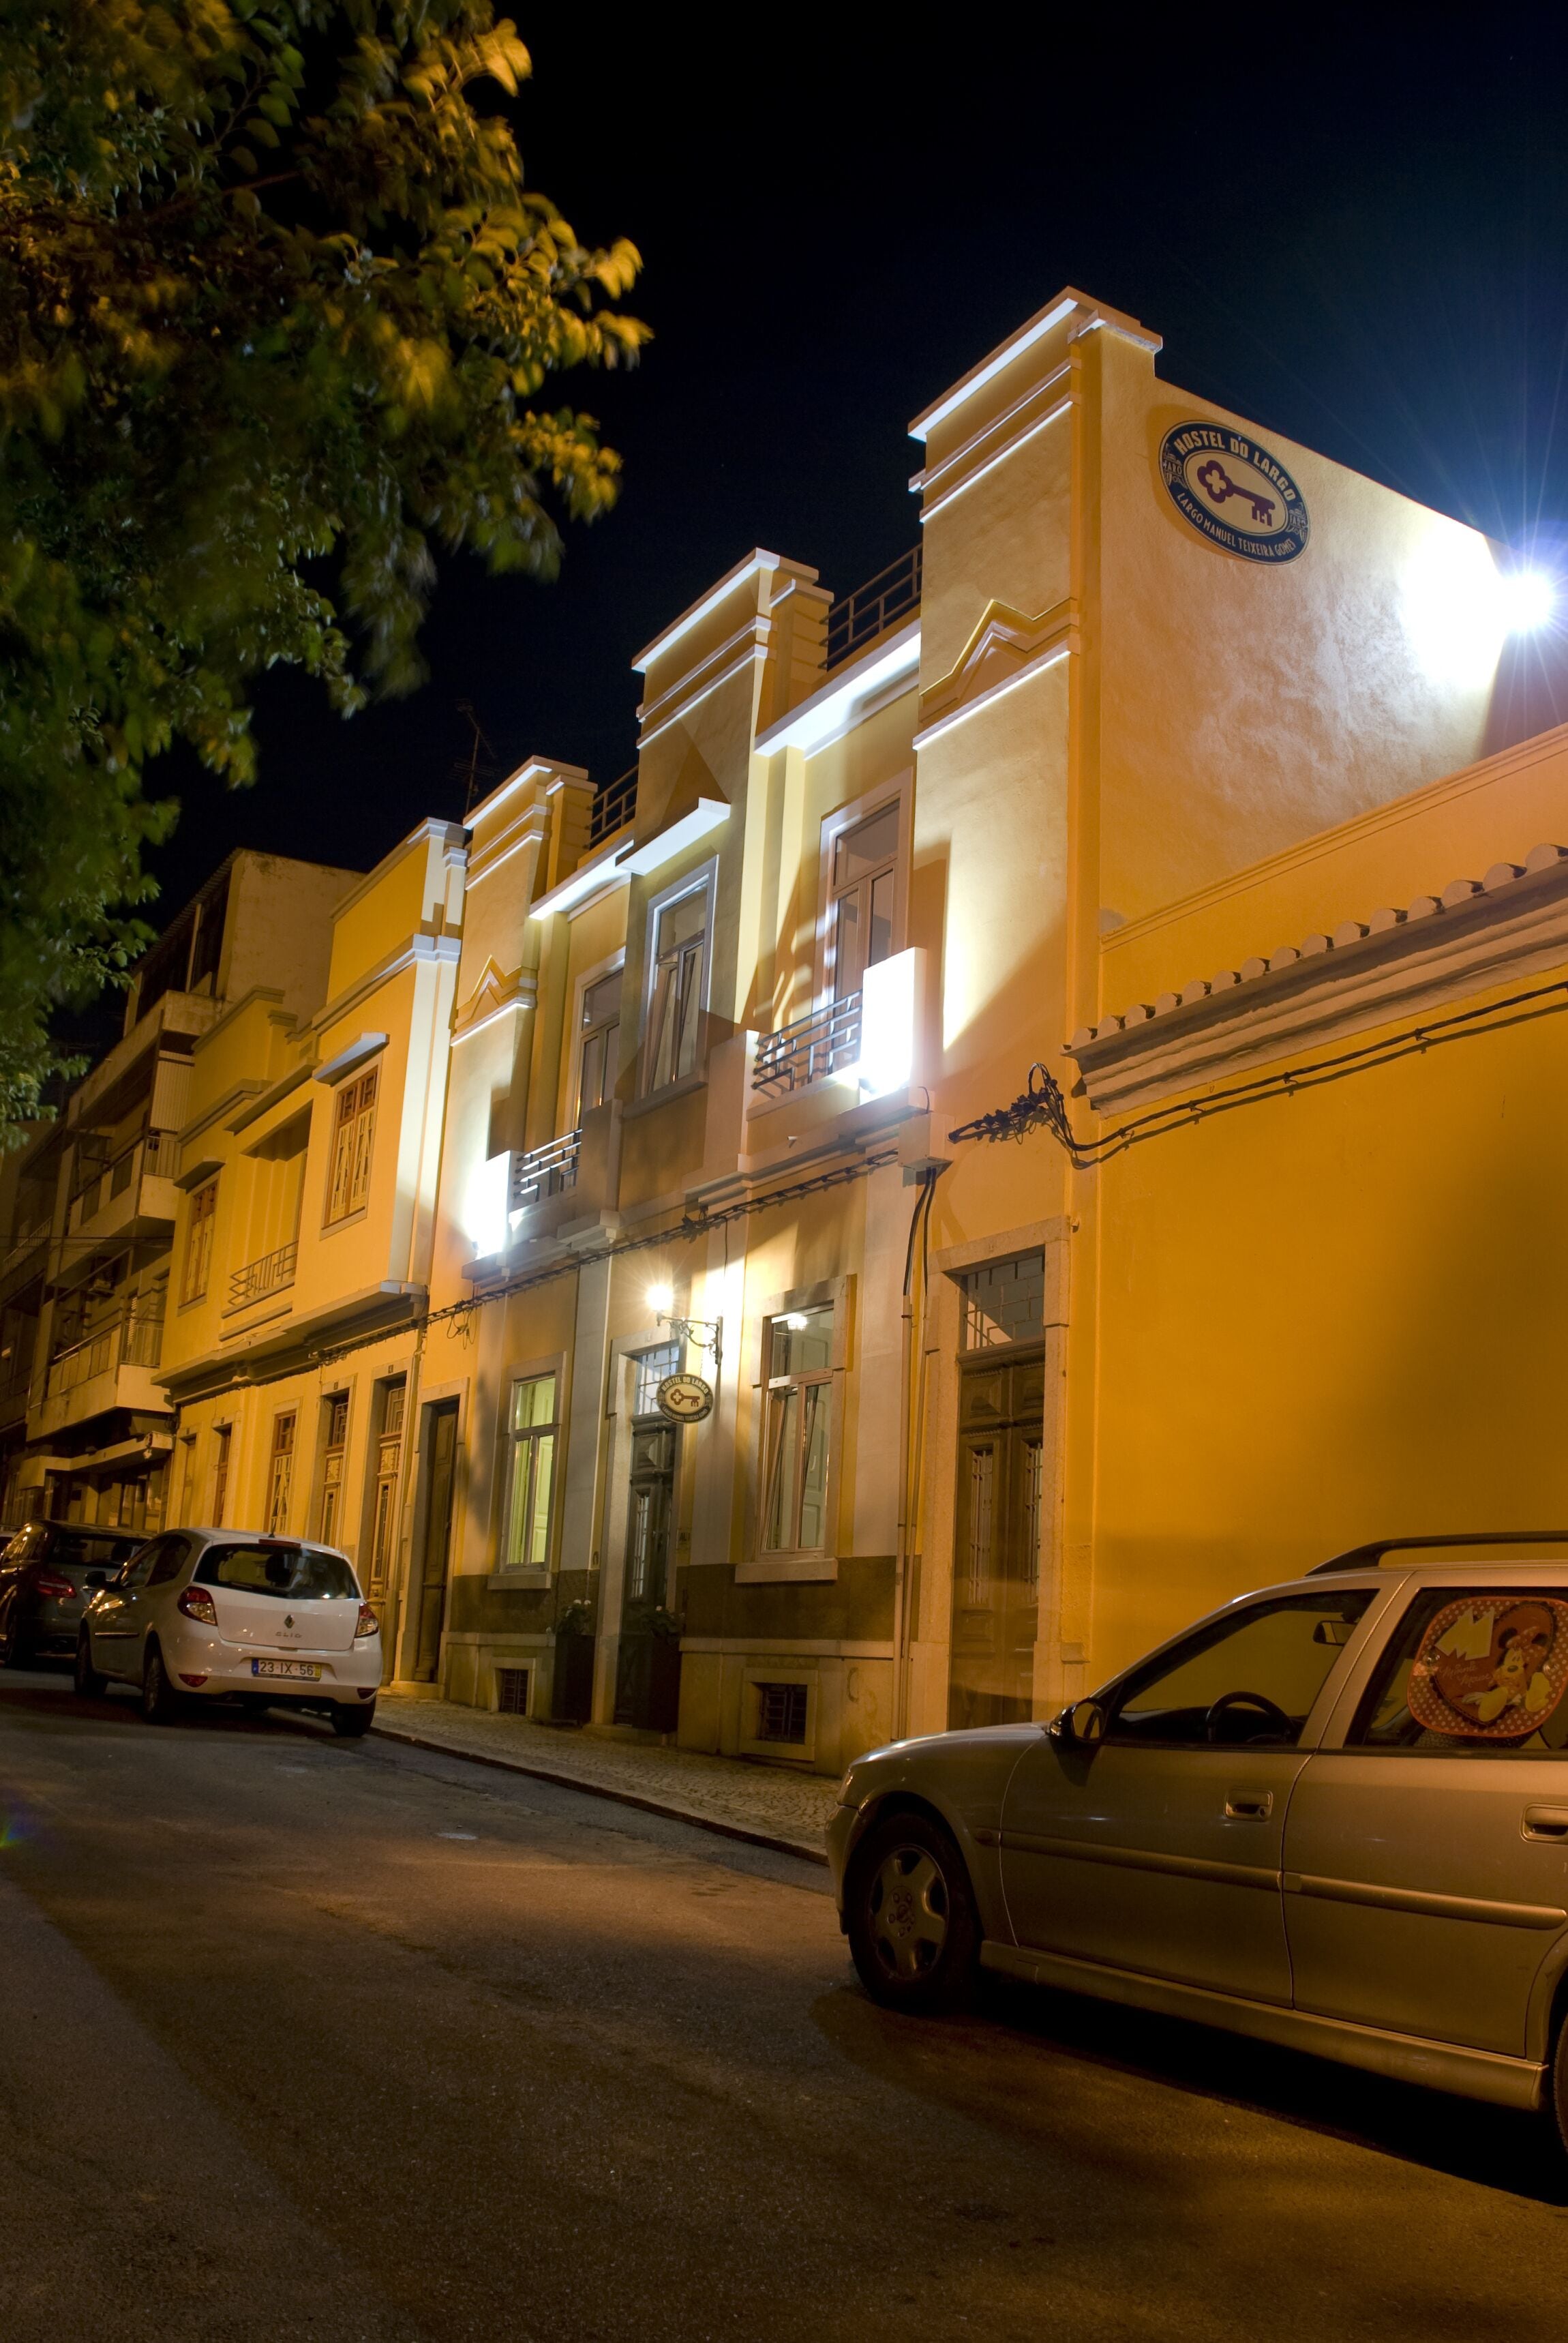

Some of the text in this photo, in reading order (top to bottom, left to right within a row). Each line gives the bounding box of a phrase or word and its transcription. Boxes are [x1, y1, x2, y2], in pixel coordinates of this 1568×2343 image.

[1174, 430, 1297, 502] HOSTEL DO LARGO
[1177, 492, 1204, 524] LARGO
[1203, 518, 1236, 547] MANUEL
[1237, 537, 1275, 557] TEIXEIRA
[661, 1377, 682, 1392] HOSTEL
[692, 1377, 709, 1394] LARGO
